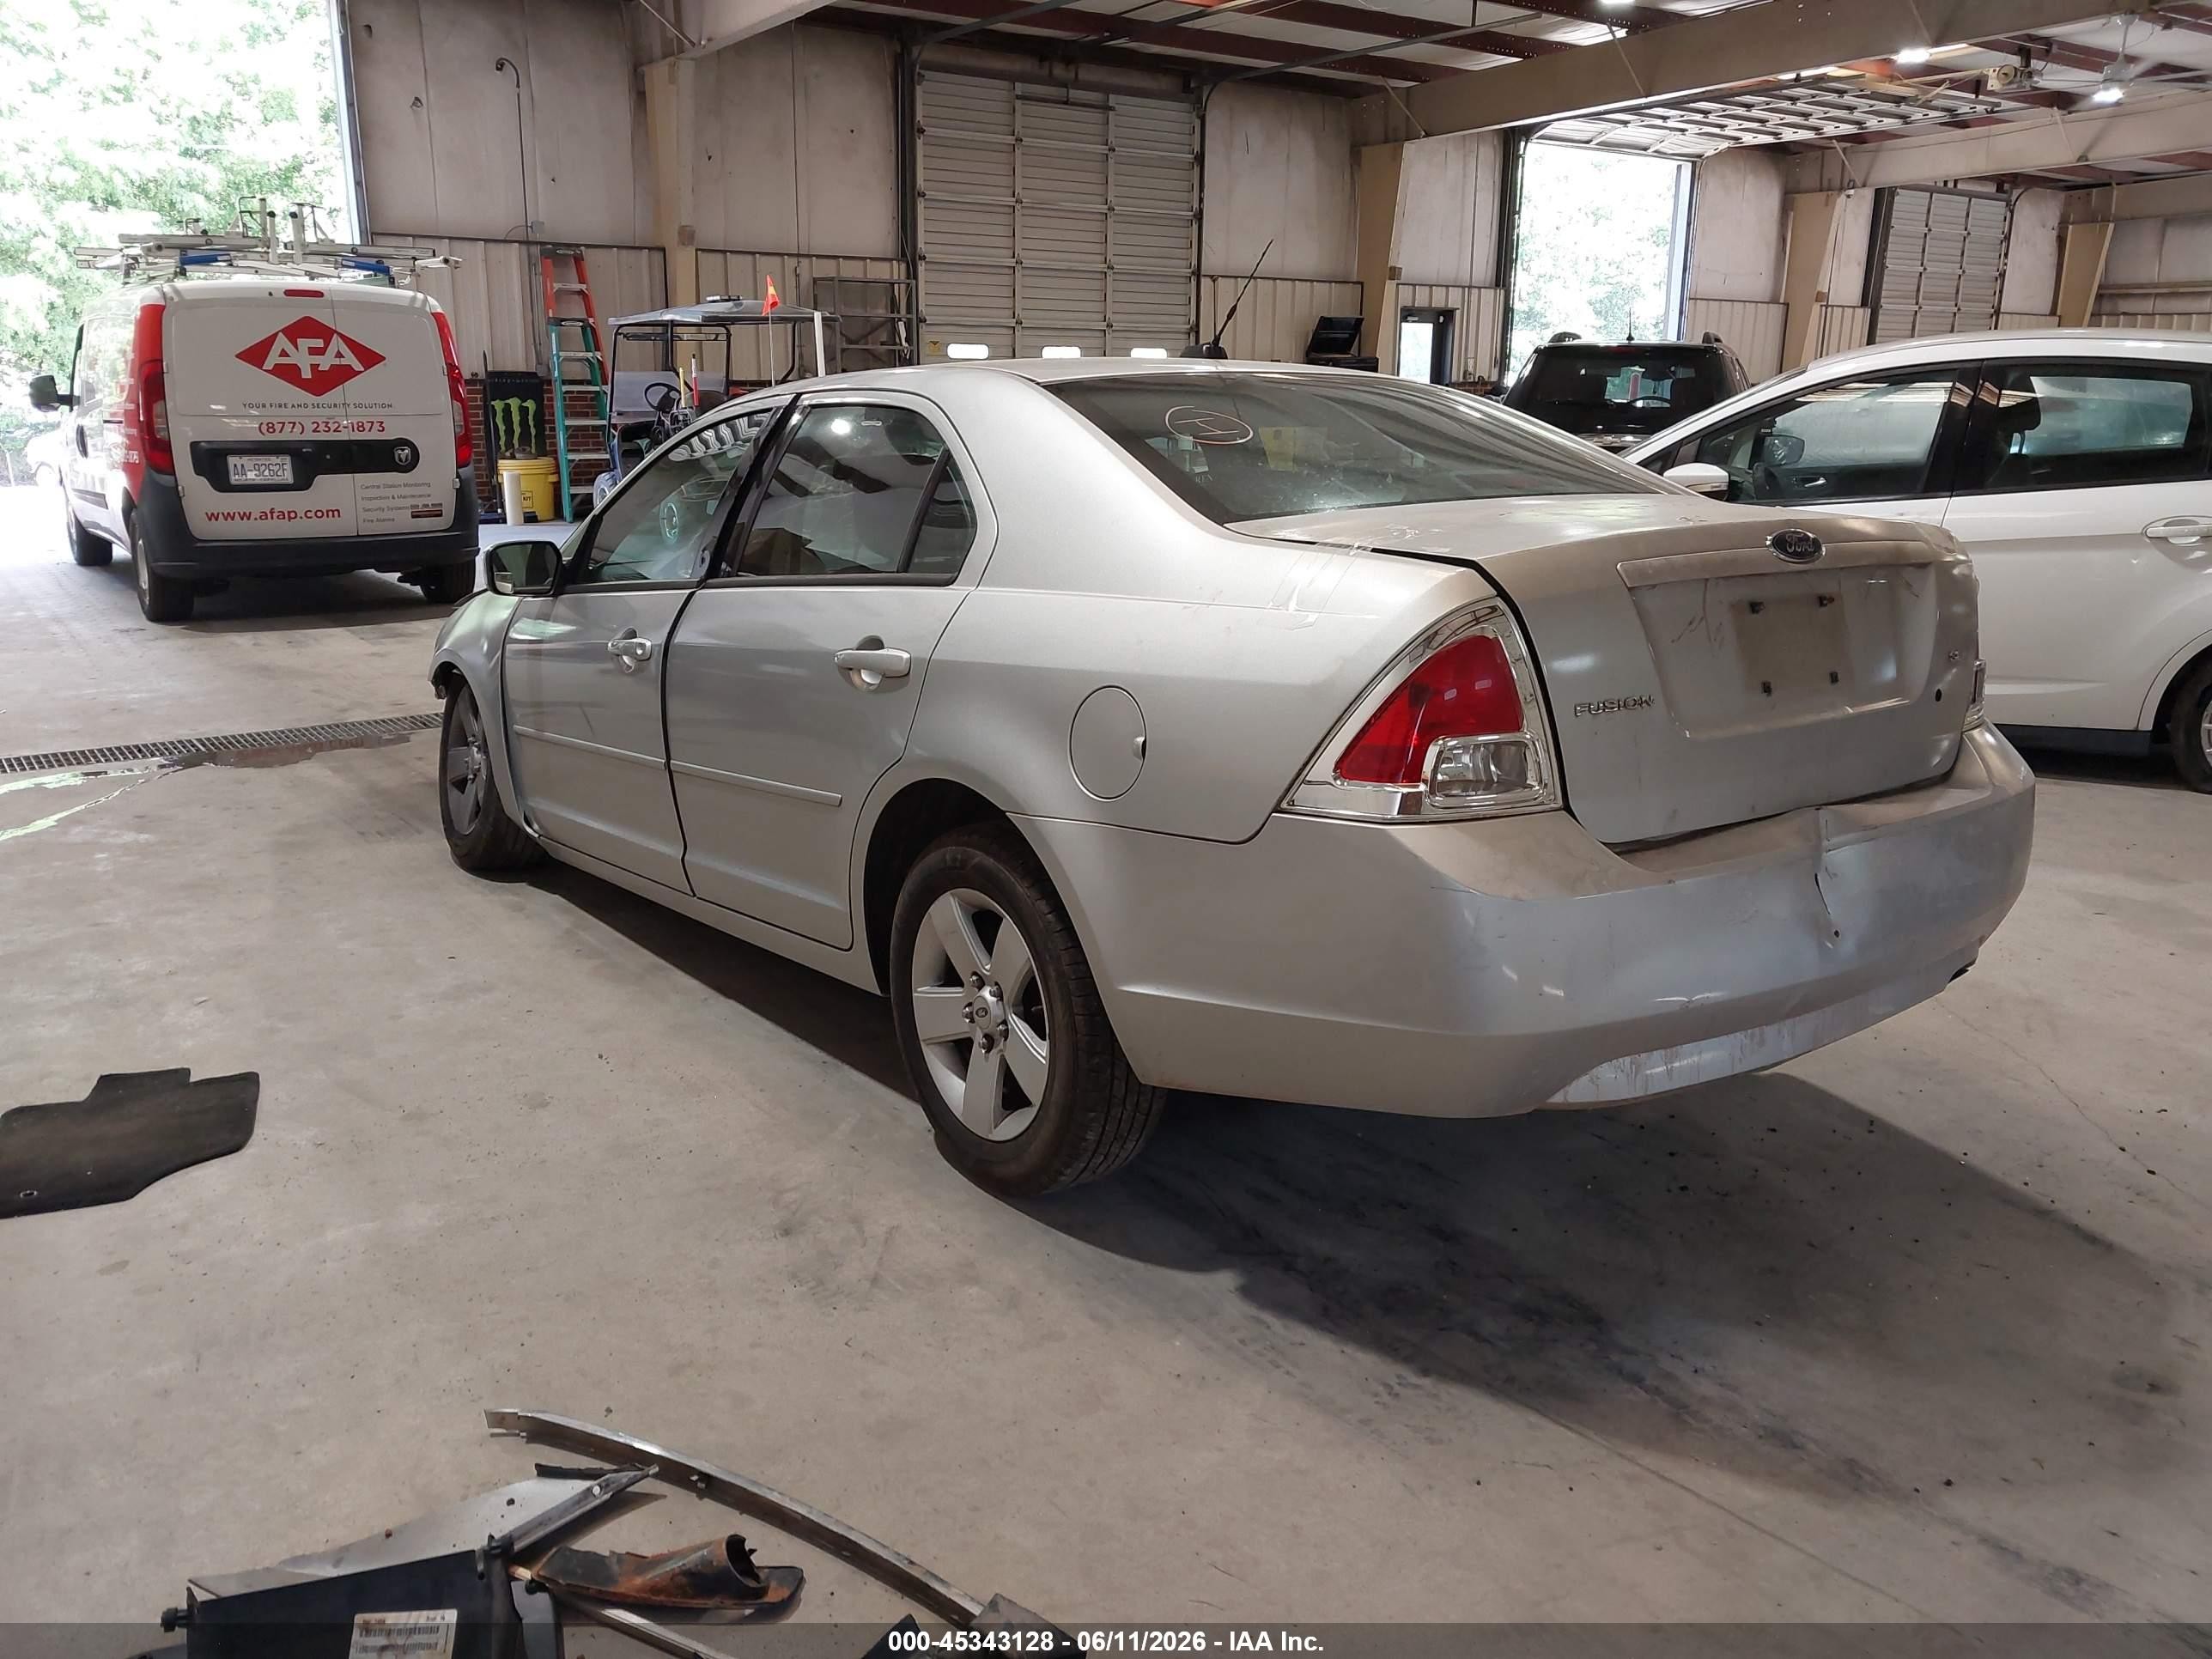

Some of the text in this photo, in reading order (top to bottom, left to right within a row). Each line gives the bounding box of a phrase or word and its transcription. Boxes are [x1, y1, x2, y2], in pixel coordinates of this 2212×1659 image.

[262, 331, 364, 379] AFA
[258, 421, 386, 435] (877) 232-1873
[233, 463, 288, 477] AA-9262F
[205, 507, 341, 522] www.afap.com
[1786, 533, 1814, 552] Ford
[1574, 695, 1654, 716] FUSION
